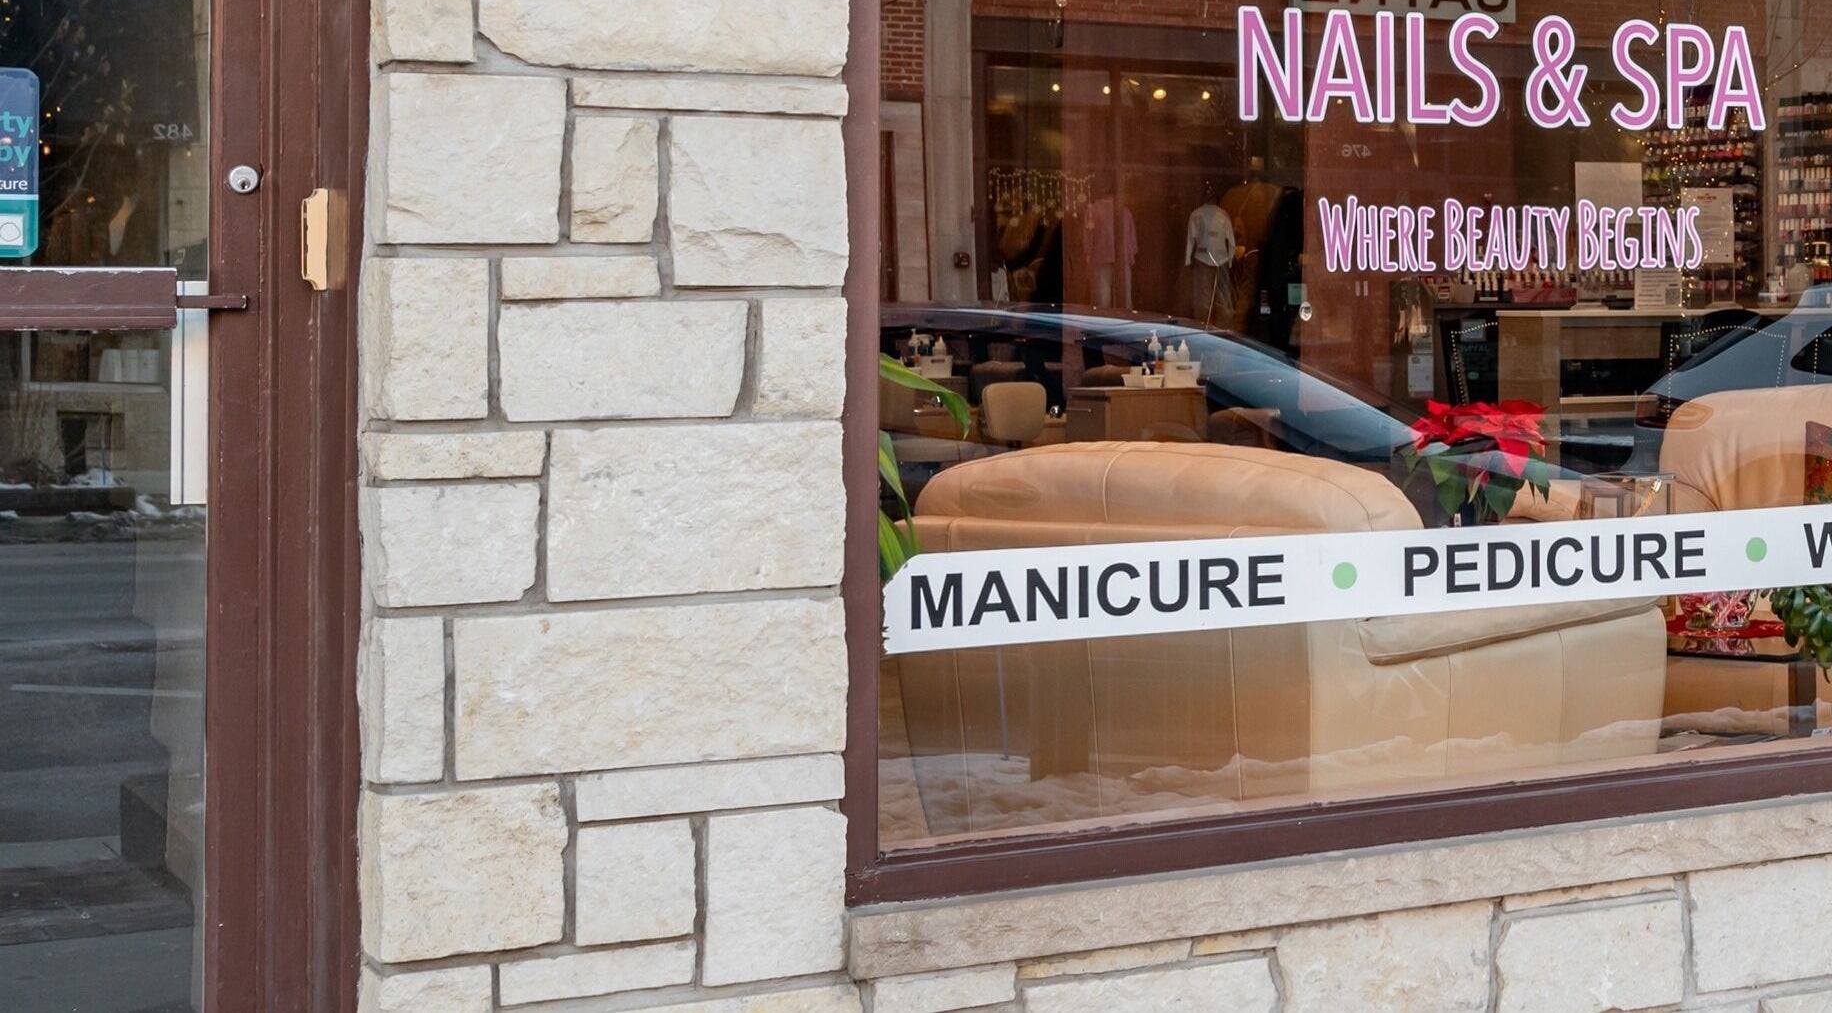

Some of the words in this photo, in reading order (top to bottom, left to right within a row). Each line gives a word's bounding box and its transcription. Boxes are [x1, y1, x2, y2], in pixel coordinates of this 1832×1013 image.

[1237, 6, 1500, 127] NAILS
[1525, 14, 1591, 128] &
[1610, 18, 1767, 131] SPA
[1318, 195, 1436, 273] WHERE
[1443, 198, 1570, 272] BEAUTY
[1577, 199, 1703, 271] BEGINS
[910, 553, 1285, 630] MANICURE
[1404, 529, 1706, 597] PEDICURE
